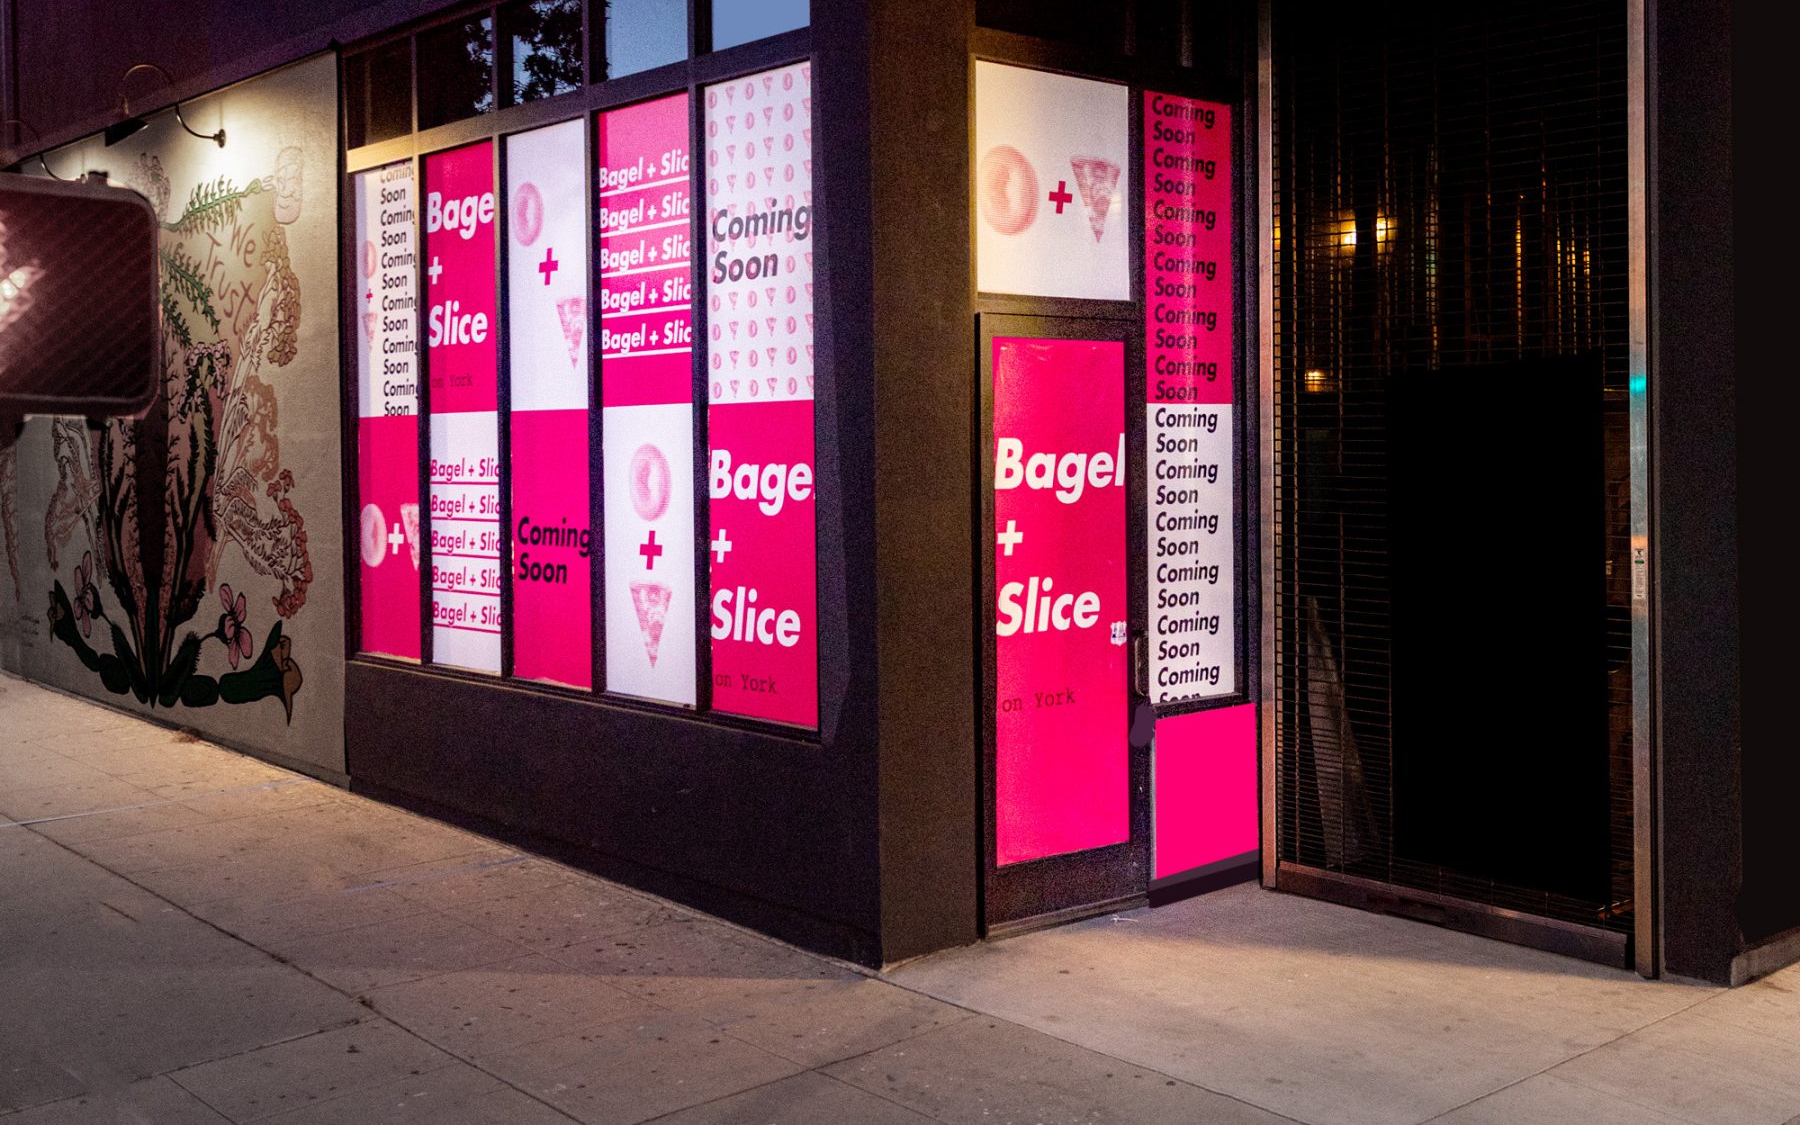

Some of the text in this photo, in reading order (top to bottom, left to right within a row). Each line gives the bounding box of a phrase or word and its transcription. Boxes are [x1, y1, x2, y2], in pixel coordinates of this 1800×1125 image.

[1152, 96, 1215, 129] Coming
[1153, 121, 1195, 144] Soon
[599, 156, 644, 191] Bagel
[647, 163, 656, 178] +
[1153, 148, 1216, 180] Coming
[380, 187, 406, 205] Soon
[1153, 173, 1196, 196] Soon
[427, 191, 495, 240] Bage
[600, 198, 645, 231] Bagel
[647, 205, 657, 220] +
[712, 198, 812, 241] Coming
[1153, 200, 1216, 231] Coming
[381, 230, 407, 247] Soon
[1153, 225, 1196, 246] Soon
[601, 239, 645, 273] Bagel
[648, 246, 658, 262] +
[713, 251, 778, 284] Soon
[1154, 251, 1216, 281] Coming
[382, 273, 408, 290] Soon
[1154, 277, 1197, 297] Soon
[601, 281, 646, 313] Bagel
[649, 288, 658, 304] +
[382, 316, 408, 333] Soon
[429, 300, 488, 347] Slice
[1155, 303, 1217, 331] Coming
[602, 323, 647, 354] Bagel
[649, 330, 659, 346] +
[1155, 328, 1197, 349] Soon
[383, 359, 409, 375] Soon
[1155, 355, 1217, 382] Coming
[1155, 381, 1198, 400] Soon
[384, 401, 410, 416] Soon
[1155, 407, 1218, 433] Coming
[1155, 433, 1198, 453] Soon
[430, 457, 465, 482] Bagel
[468, 465, 474, 476] +
[994, 433, 1125, 504] Bagel
[1155, 458, 1218, 484] Coming
[709, 449, 816, 516] Bage
[1155, 485, 1199, 505] Soon
[431, 493, 466, 518] Bagel
[469, 501, 475, 513] +
[1156, 509, 1219, 534] Coming
[432, 529, 466, 553] Bagel
[469, 537, 475, 549] +
[518, 516, 591, 558] Coming
[710, 528, 732, 563] +
[997, 520, 1023, 556] +
[1156, 537, 1199, 557] Soon
[432, 565, 467, 589] Bagel
[470, 574, 476, 586] +
[518, 552, 567, 584] Soon
[1157, 560, 1219, 584] Coming
[996, 576, 1100, 637] Slice
[1157, 589, 1199, 609] Soon
[432, 602, 467, 625] Bagel
[470, 611, 476, 623] +
[711, 586, 800, 647] Slice
[1157, 610, 1220, 635] Coming
[1157, 640, 1200, 661] Soon
[715, 674, 777, 693] on York
[1158, 661, 1220, 687] Coming
[1002, 688, 1076, 712] on York
